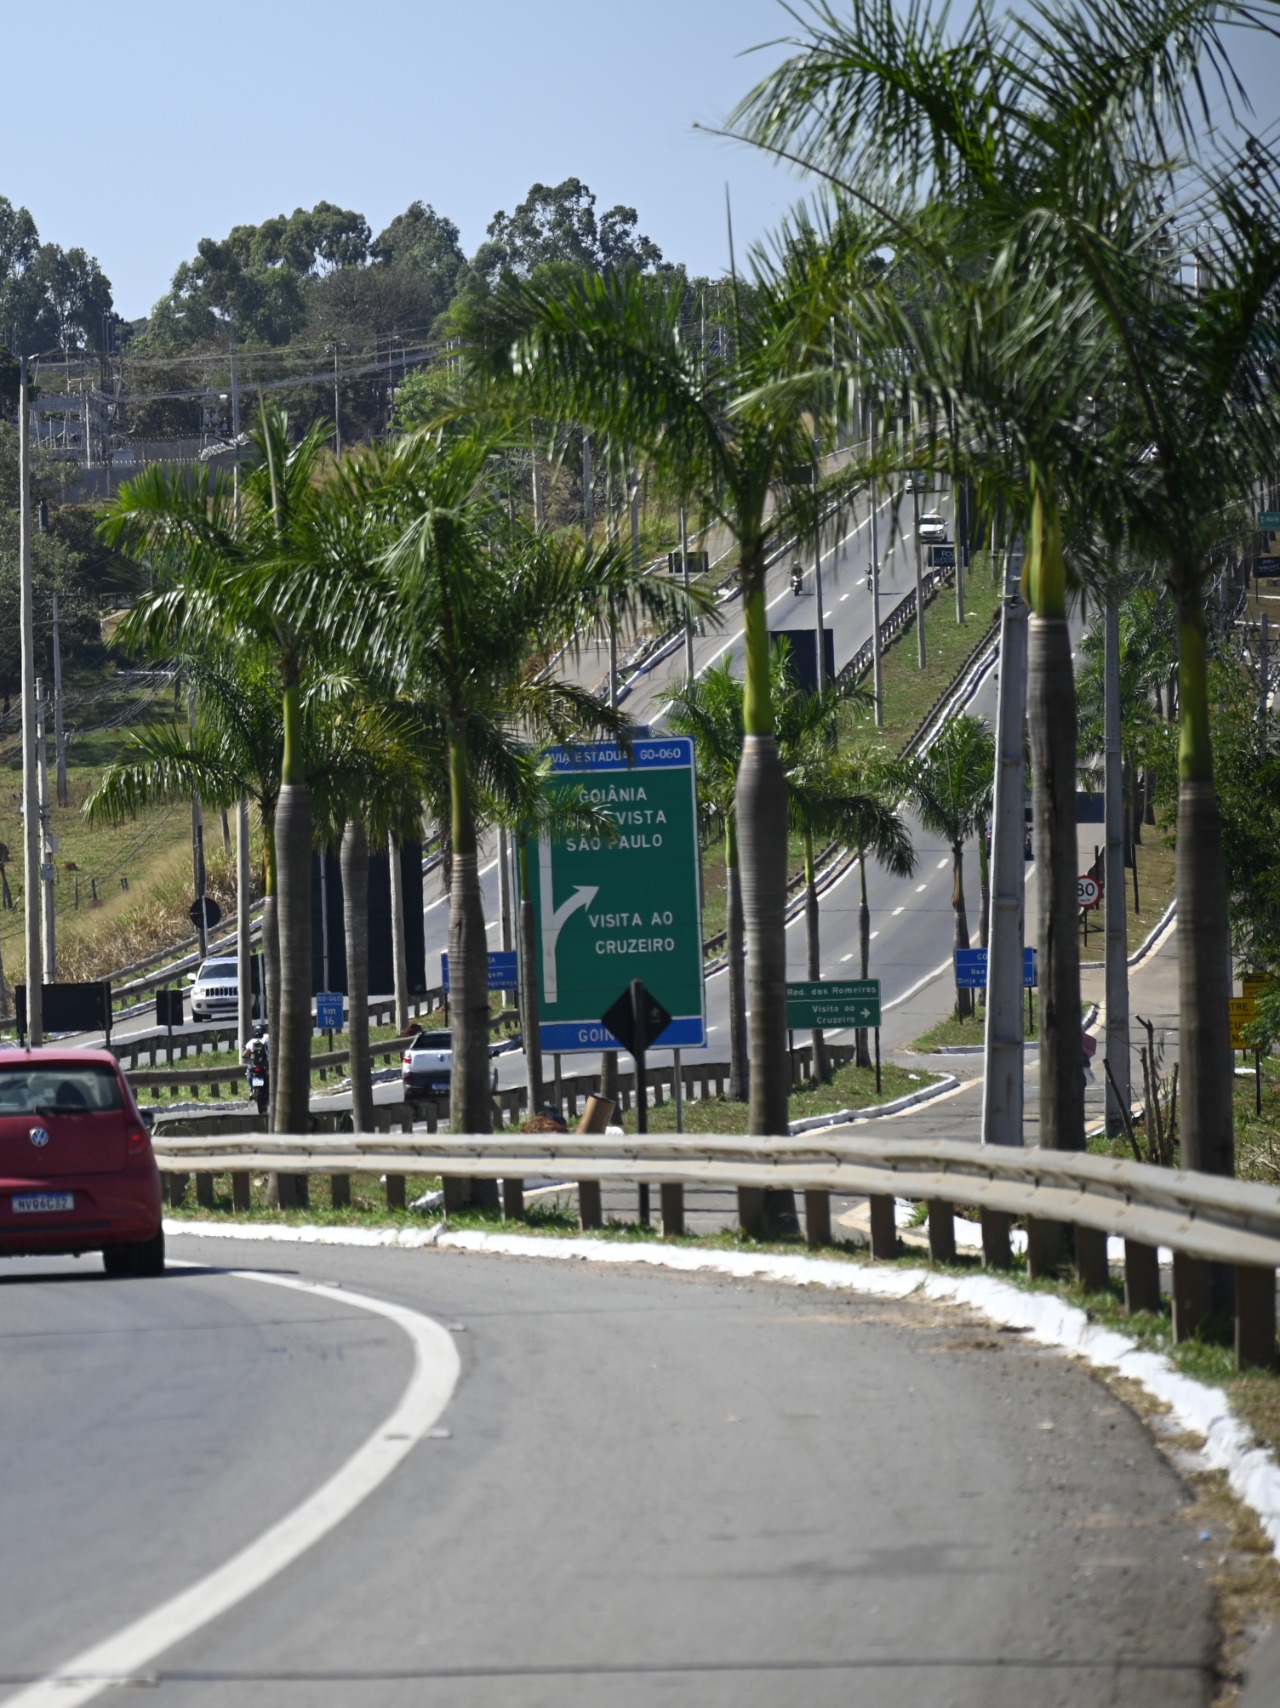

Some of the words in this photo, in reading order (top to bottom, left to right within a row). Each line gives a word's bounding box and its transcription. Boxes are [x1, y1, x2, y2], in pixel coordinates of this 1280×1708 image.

[640, 748, 681, 760] GO-060
[579, 784, 647, 803] GOIÂNIA
[617, 809, 667, 825] VISTA
[566, 834, 601, 852] SÃO
[608, 833, 663, 850] PAULO
[588, 913, 642, 928] VISITA
[651, 911, 673, 926] AO
[595, 938, 675, 955] CRUZEIRO
[811, 987, 828, 995] dos
[832, 986, 877, 995] Romeiros
[812, 1005, 839, 1014] Visita
[844, 1005, 856, 1013] ao
[816, 1015, 856, 1024] Cruzeiro
[578, 1028, 616, 1043] GOIN
